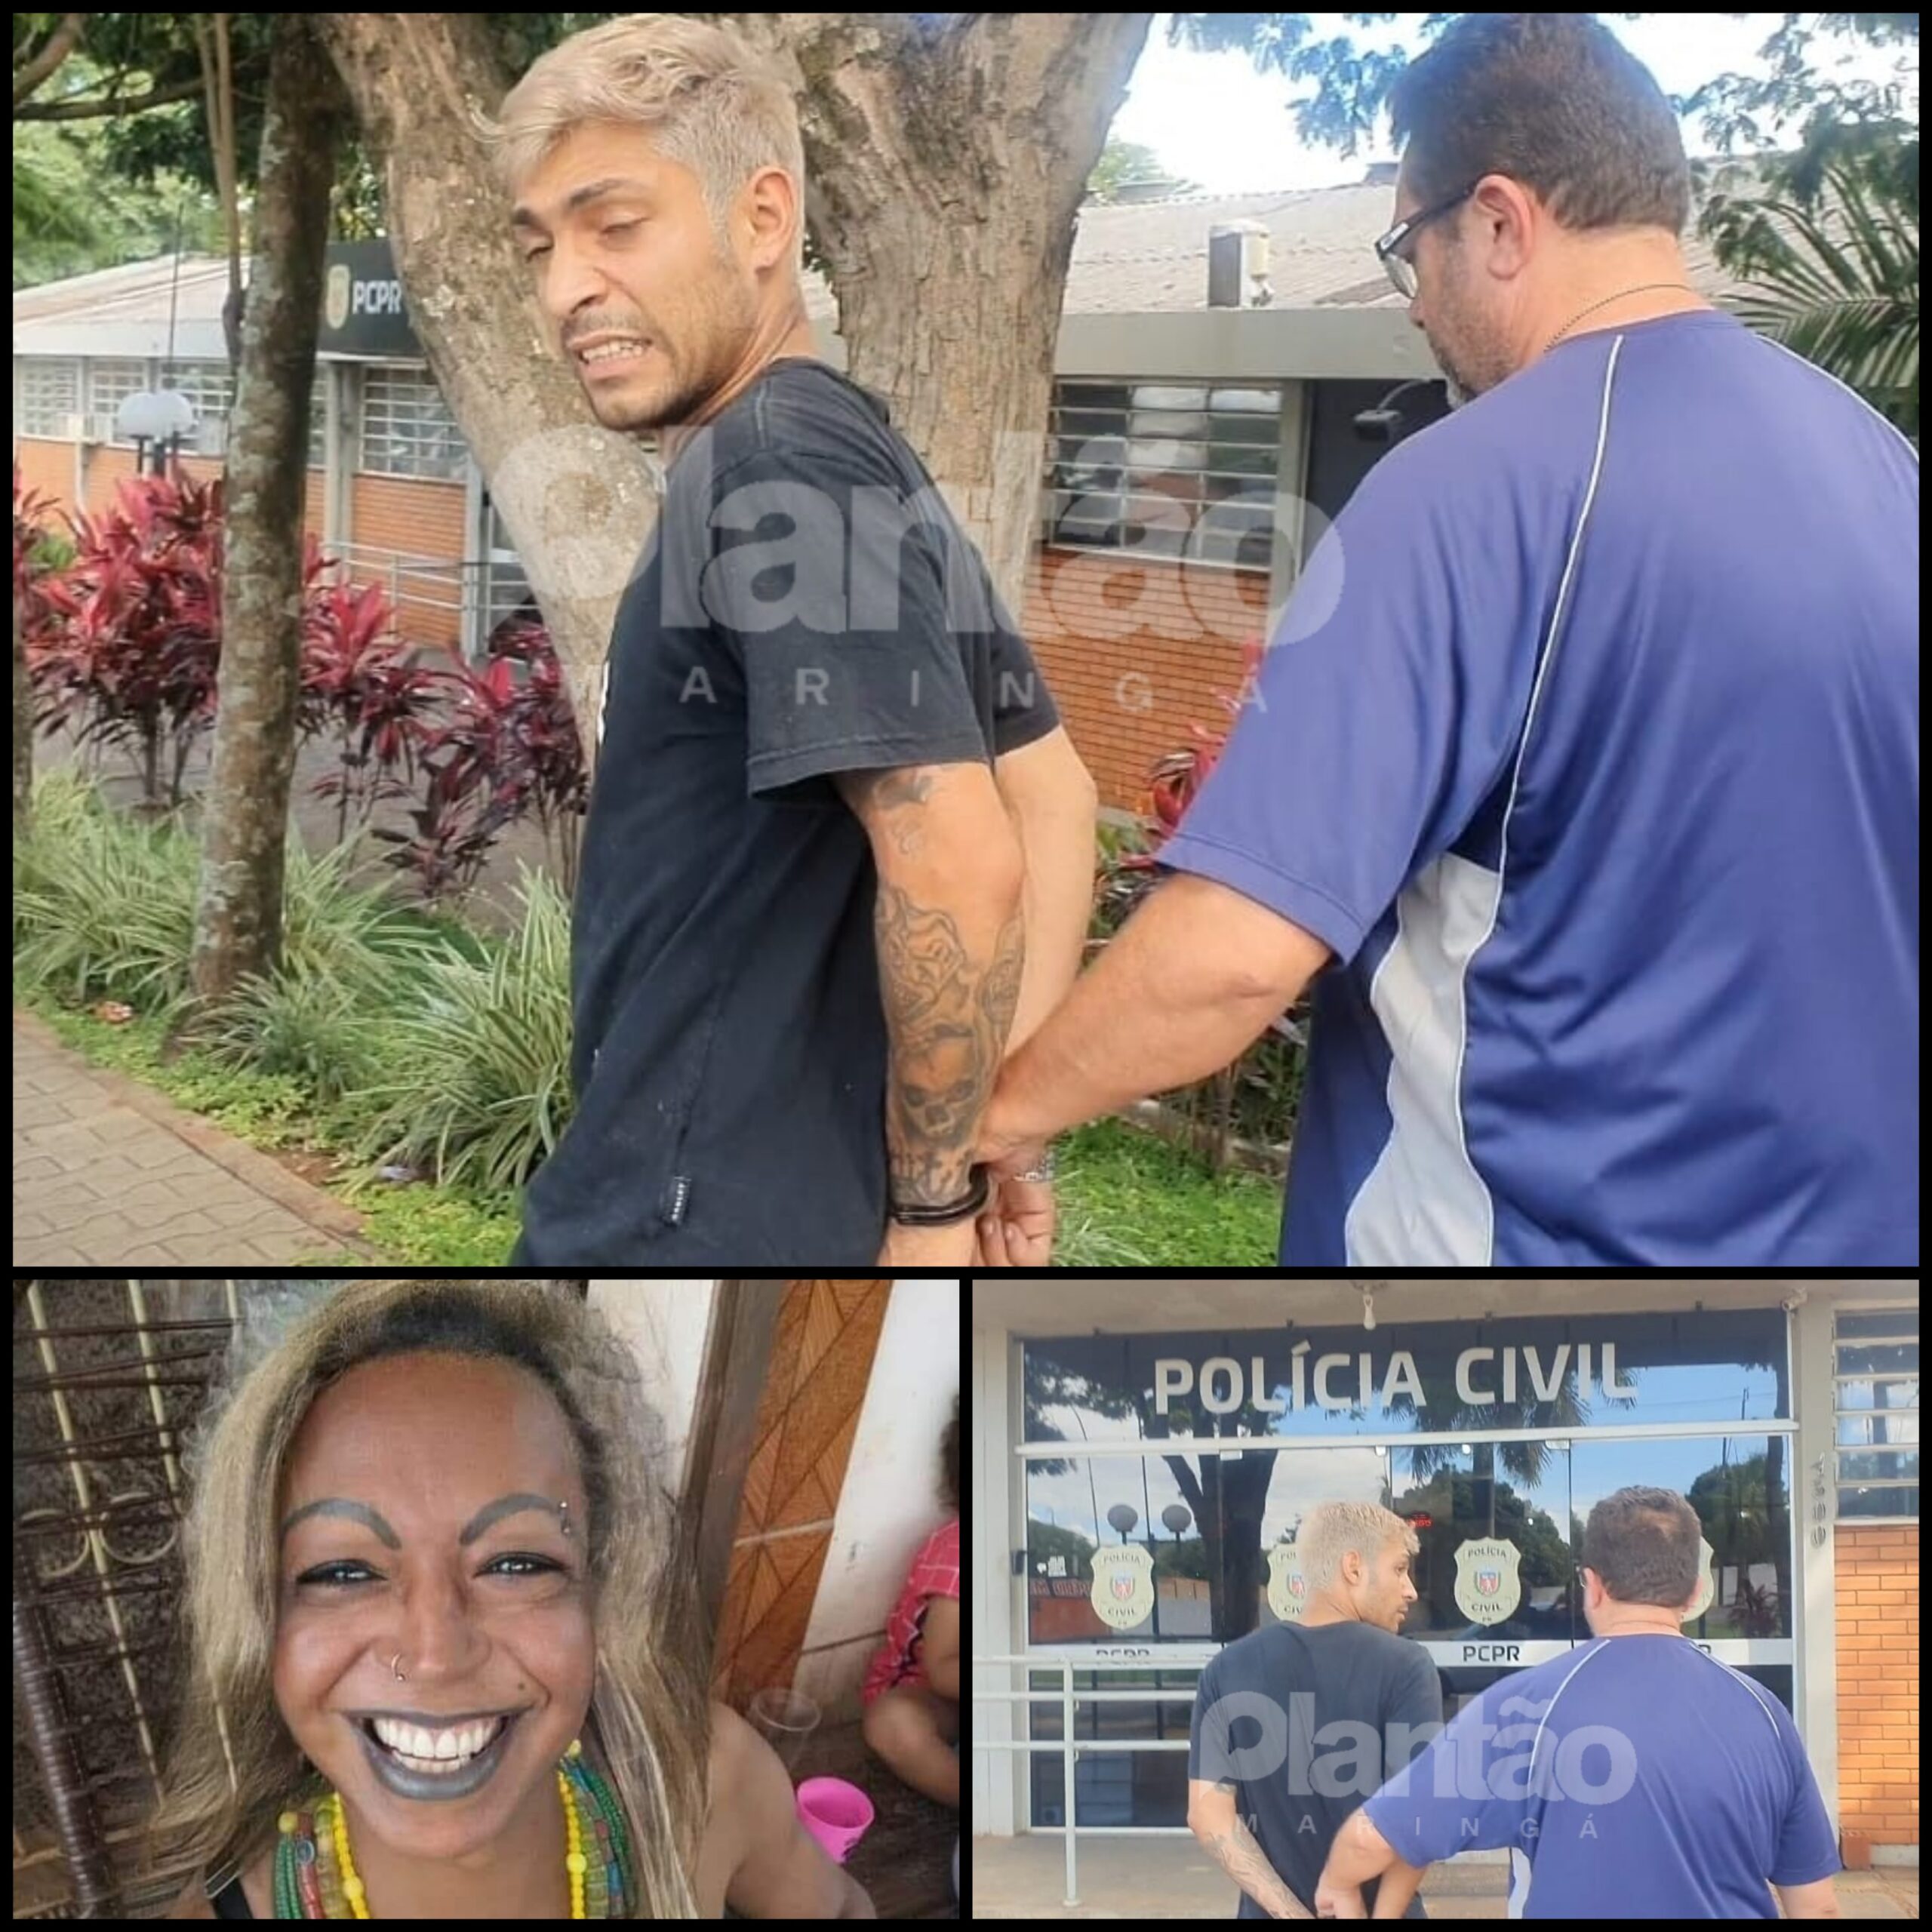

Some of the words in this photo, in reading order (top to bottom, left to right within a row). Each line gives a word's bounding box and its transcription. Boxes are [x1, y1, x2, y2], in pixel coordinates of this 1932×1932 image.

[352, 280, 401, 315] PCPR
[1155, 1340, 1427, 1416] POLÍCIA
[1455, 1343, 1638, 1406] CIVIL
[1103, 1552, 1141, 1564] POLÍCIA
[1469, 1546, 1507, 1558] POLÍCIA
[1108, 1607, 1136, 1617] CIVIL
[1472, 1602, 1503, 1613] CIVIL
[1463, 1645, 1520, 1662] PCPR
